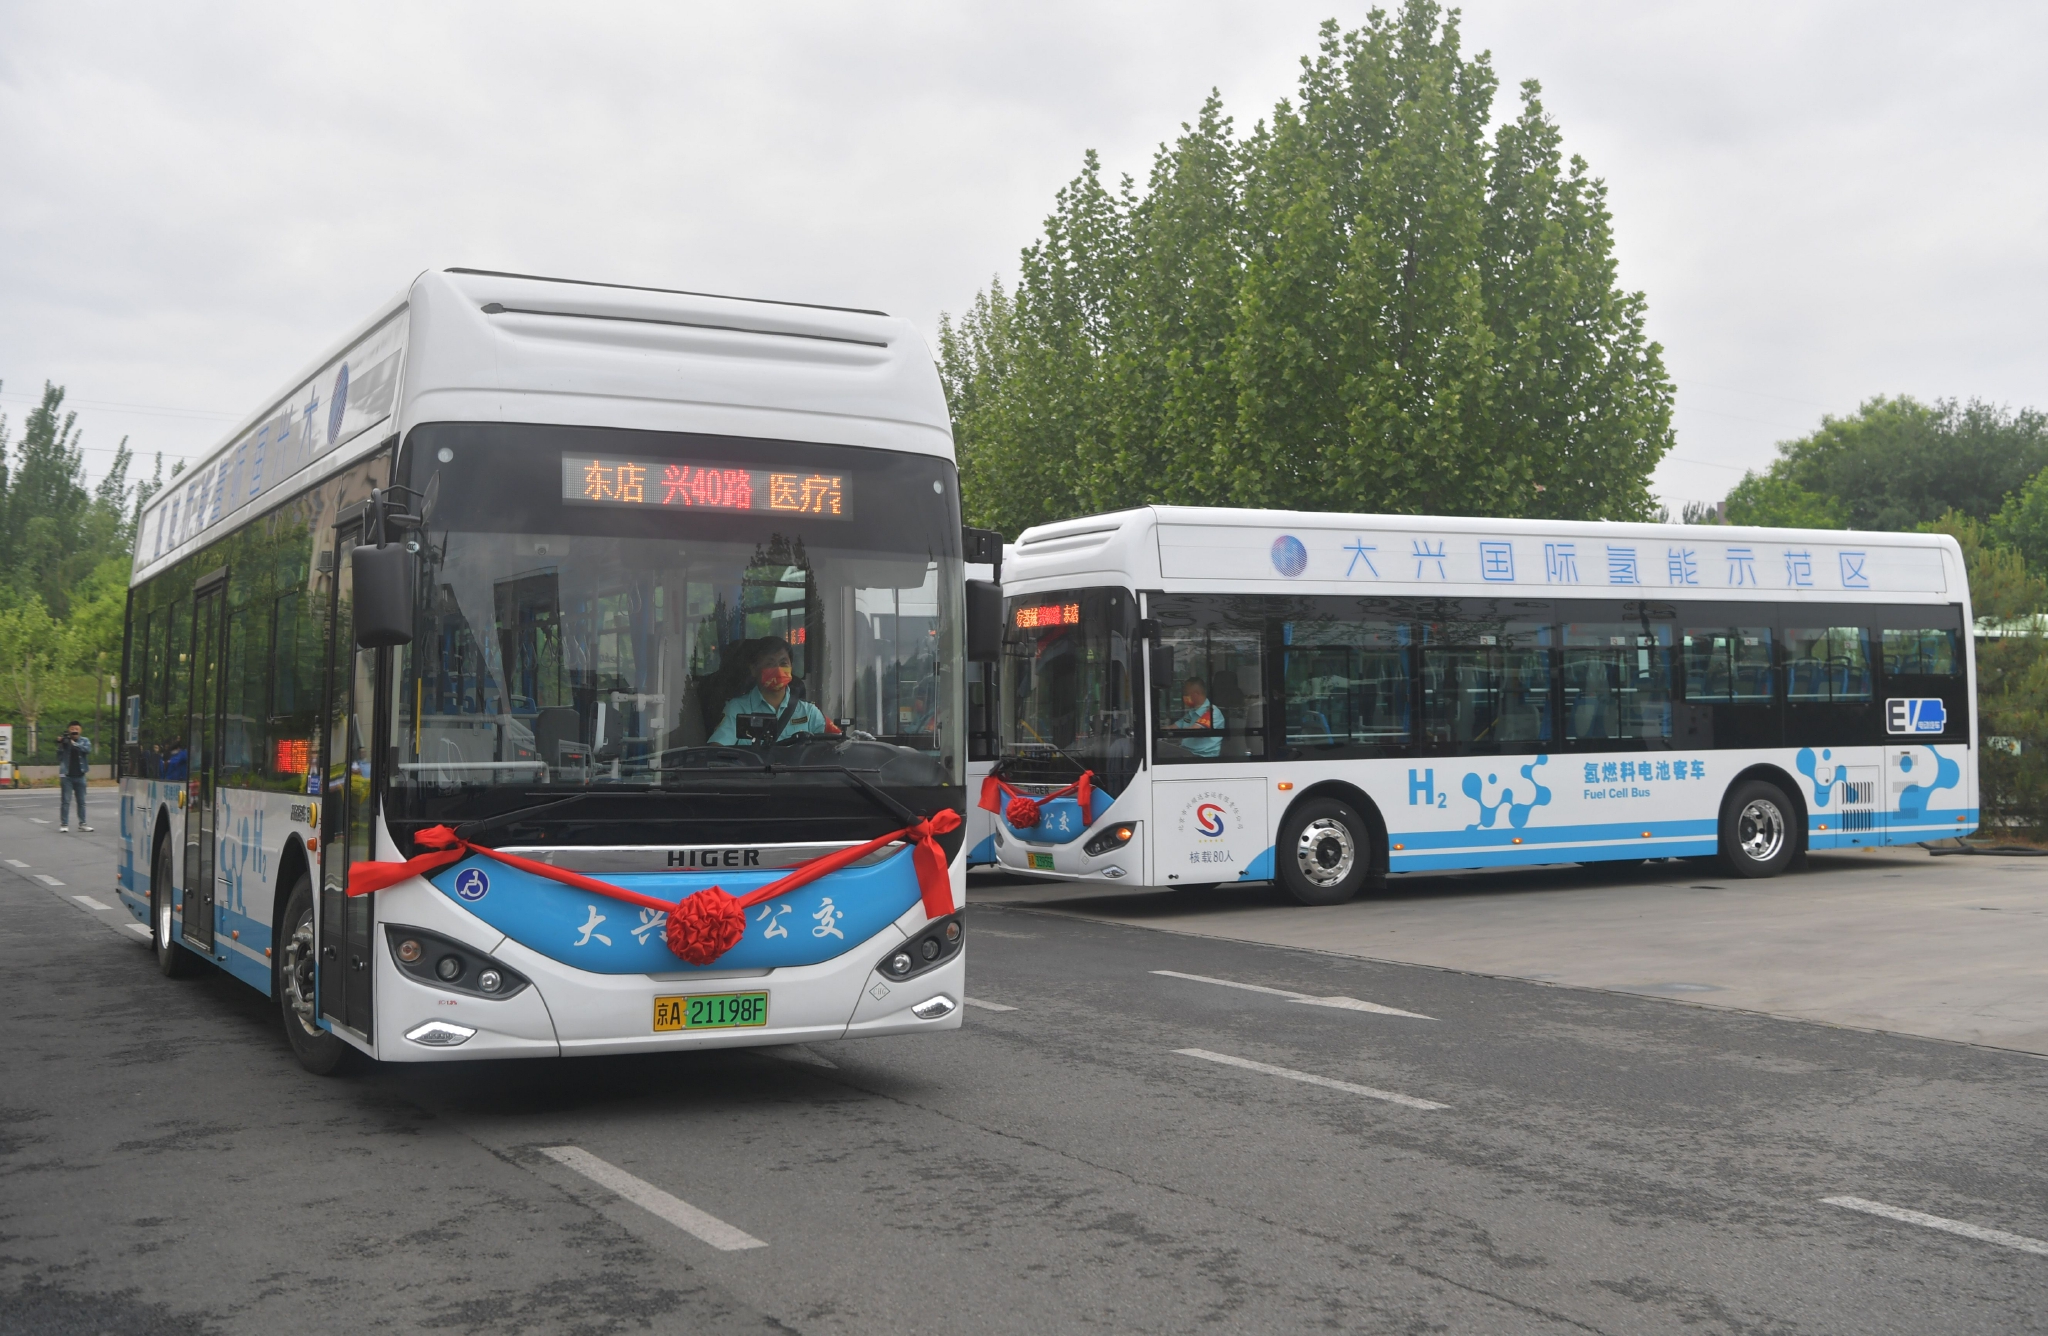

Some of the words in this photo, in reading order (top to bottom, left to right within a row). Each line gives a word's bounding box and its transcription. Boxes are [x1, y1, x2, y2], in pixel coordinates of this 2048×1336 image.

[584, 460, 647, 503] 东店
[661, 464, 753, 509] 兴40路
[1343, 538, 1869, 588] 大兴国际氢能示范区
[1583, 759, 1706, 784] 氢燃料电池客车
[1583, 789, 1606, 800] Fuel
[1608, 788, 1628, 799] Cell
[1631, 787, 1651, 798] Bus
[667, 849, 760, 867] HIGER
[1189, 849, 1234, 864] 核载80人
